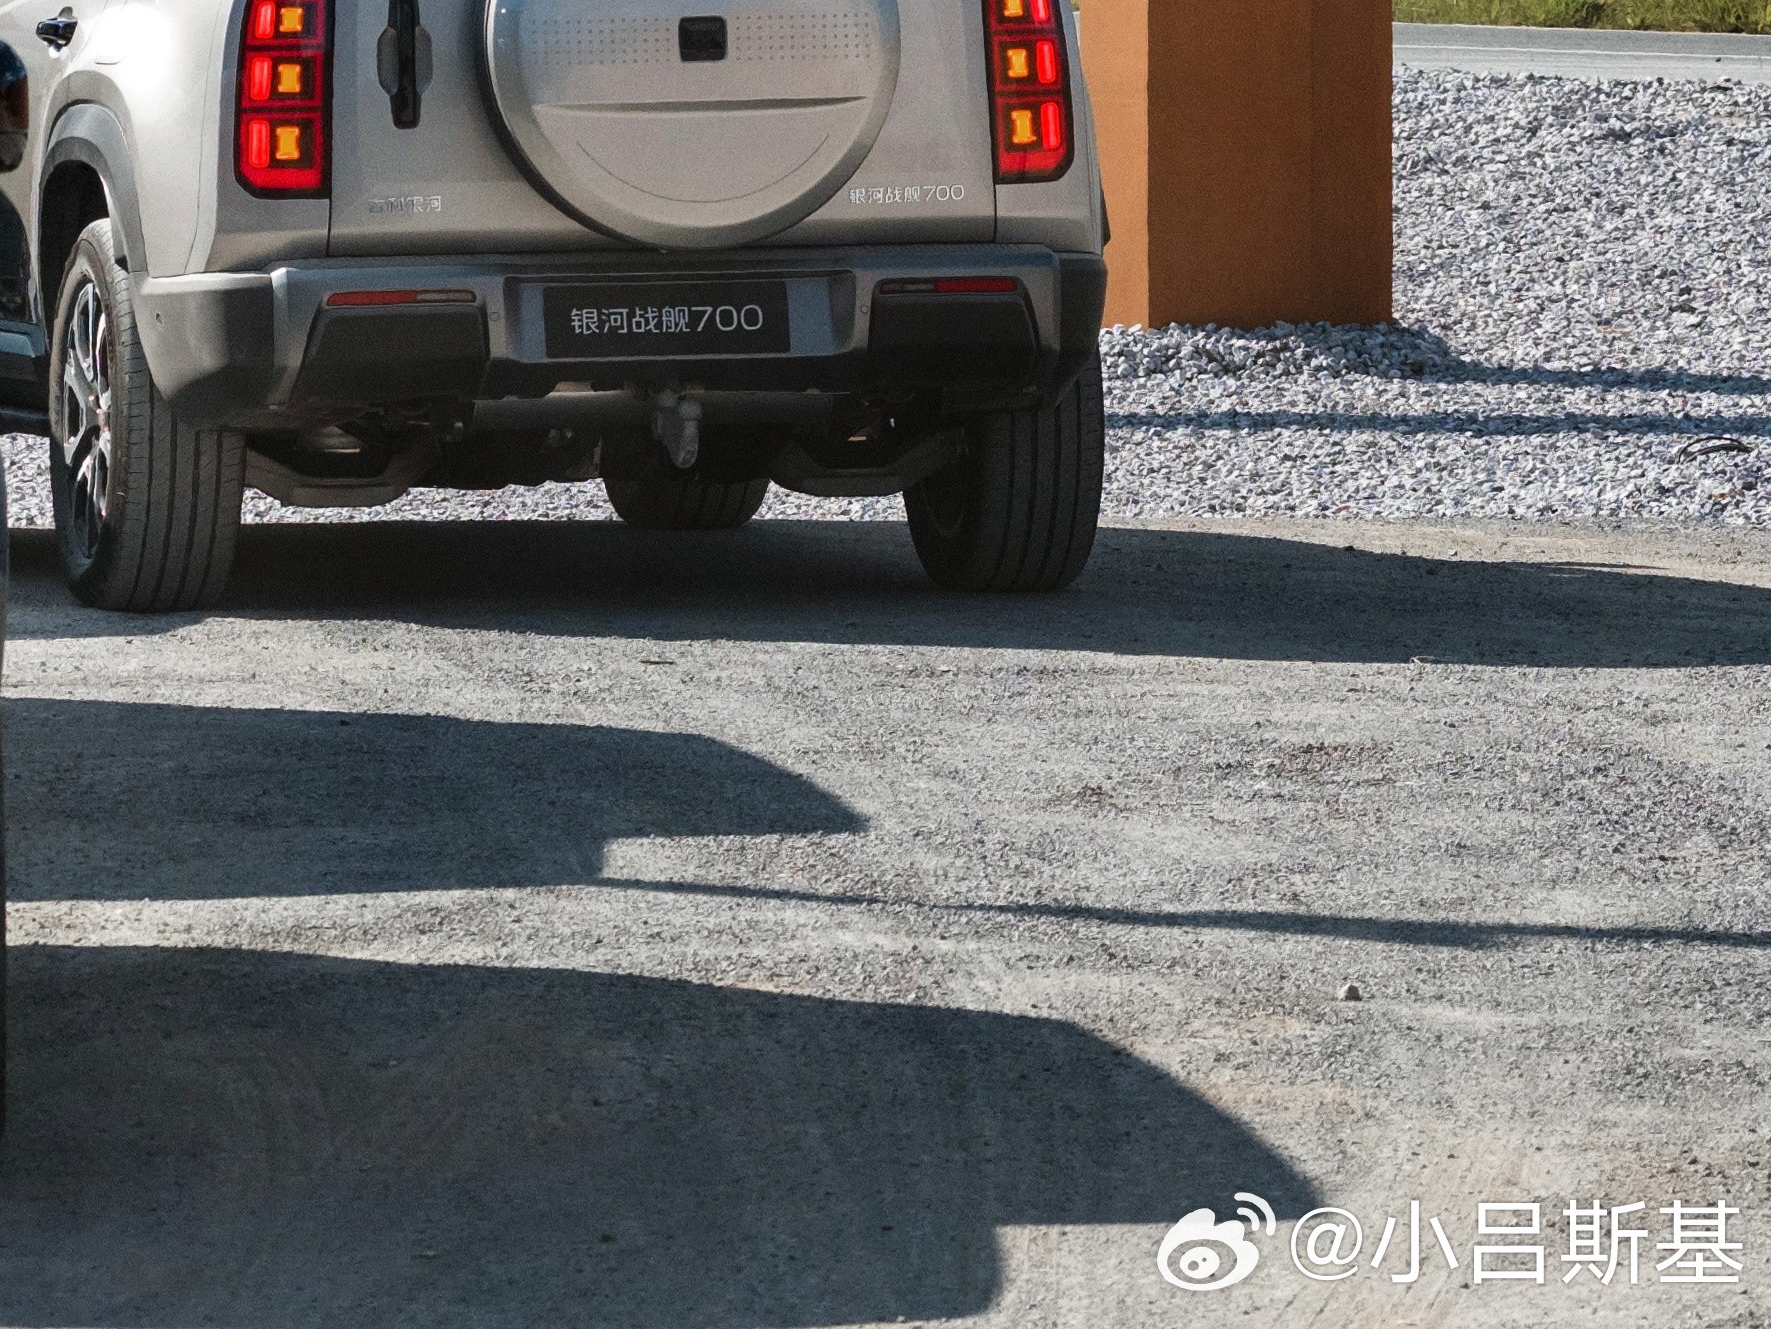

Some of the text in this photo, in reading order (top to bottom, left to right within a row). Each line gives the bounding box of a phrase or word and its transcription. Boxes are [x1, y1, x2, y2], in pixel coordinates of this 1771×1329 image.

[849, 184, 965, 204] 银河战舰700
[570, 304, 764, 335] 银河战舰700
